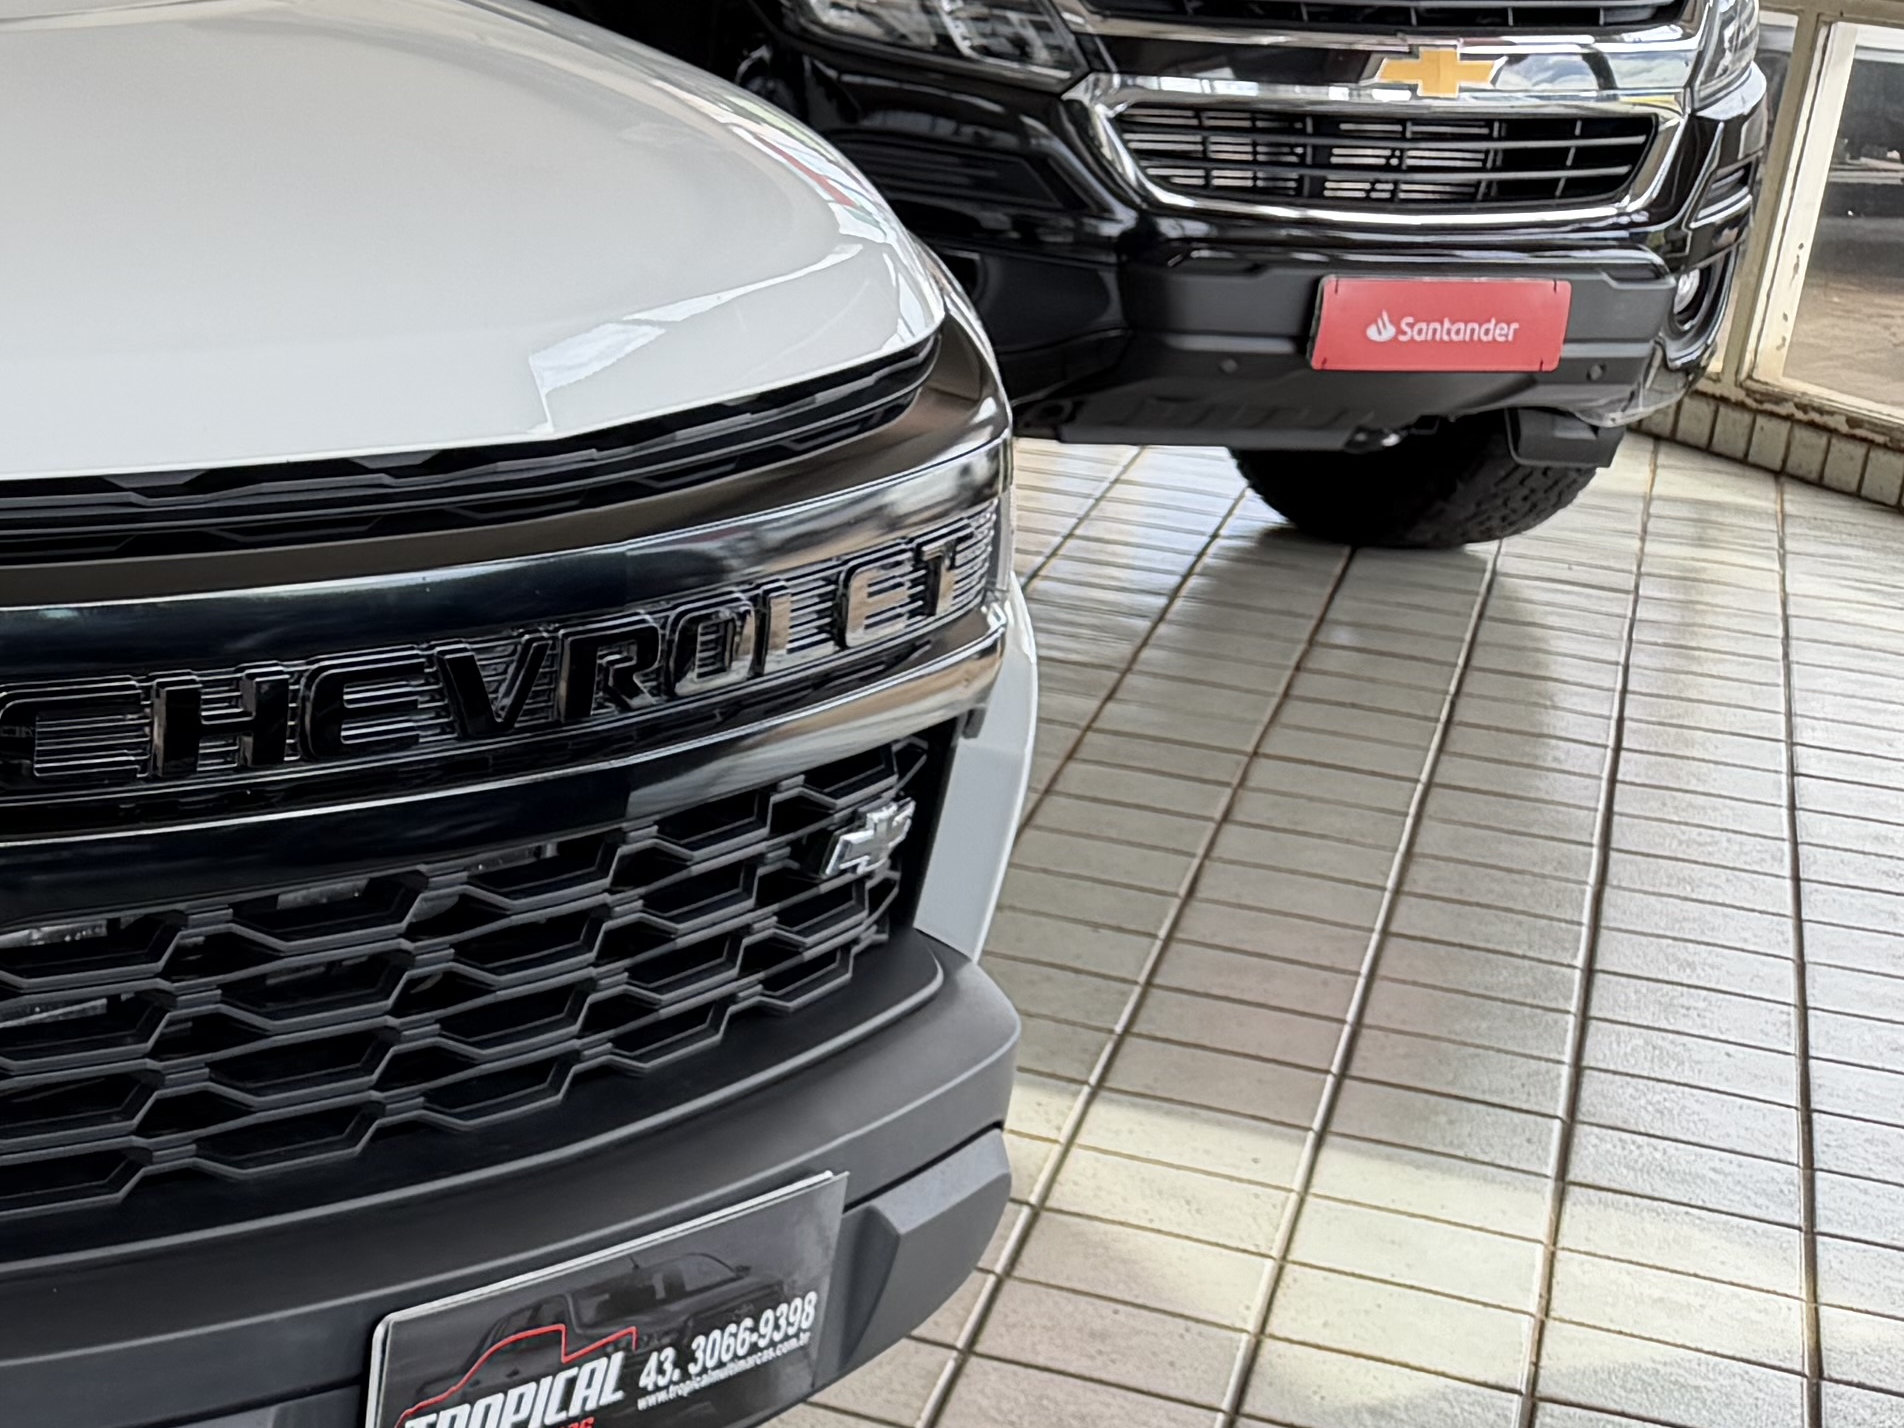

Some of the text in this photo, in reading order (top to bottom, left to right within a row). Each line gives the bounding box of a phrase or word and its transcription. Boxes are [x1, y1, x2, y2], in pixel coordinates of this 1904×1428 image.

[1398, 316, 1520, 342] Santander
[638, 1290, 818, 1392] 43. 3066-9398
